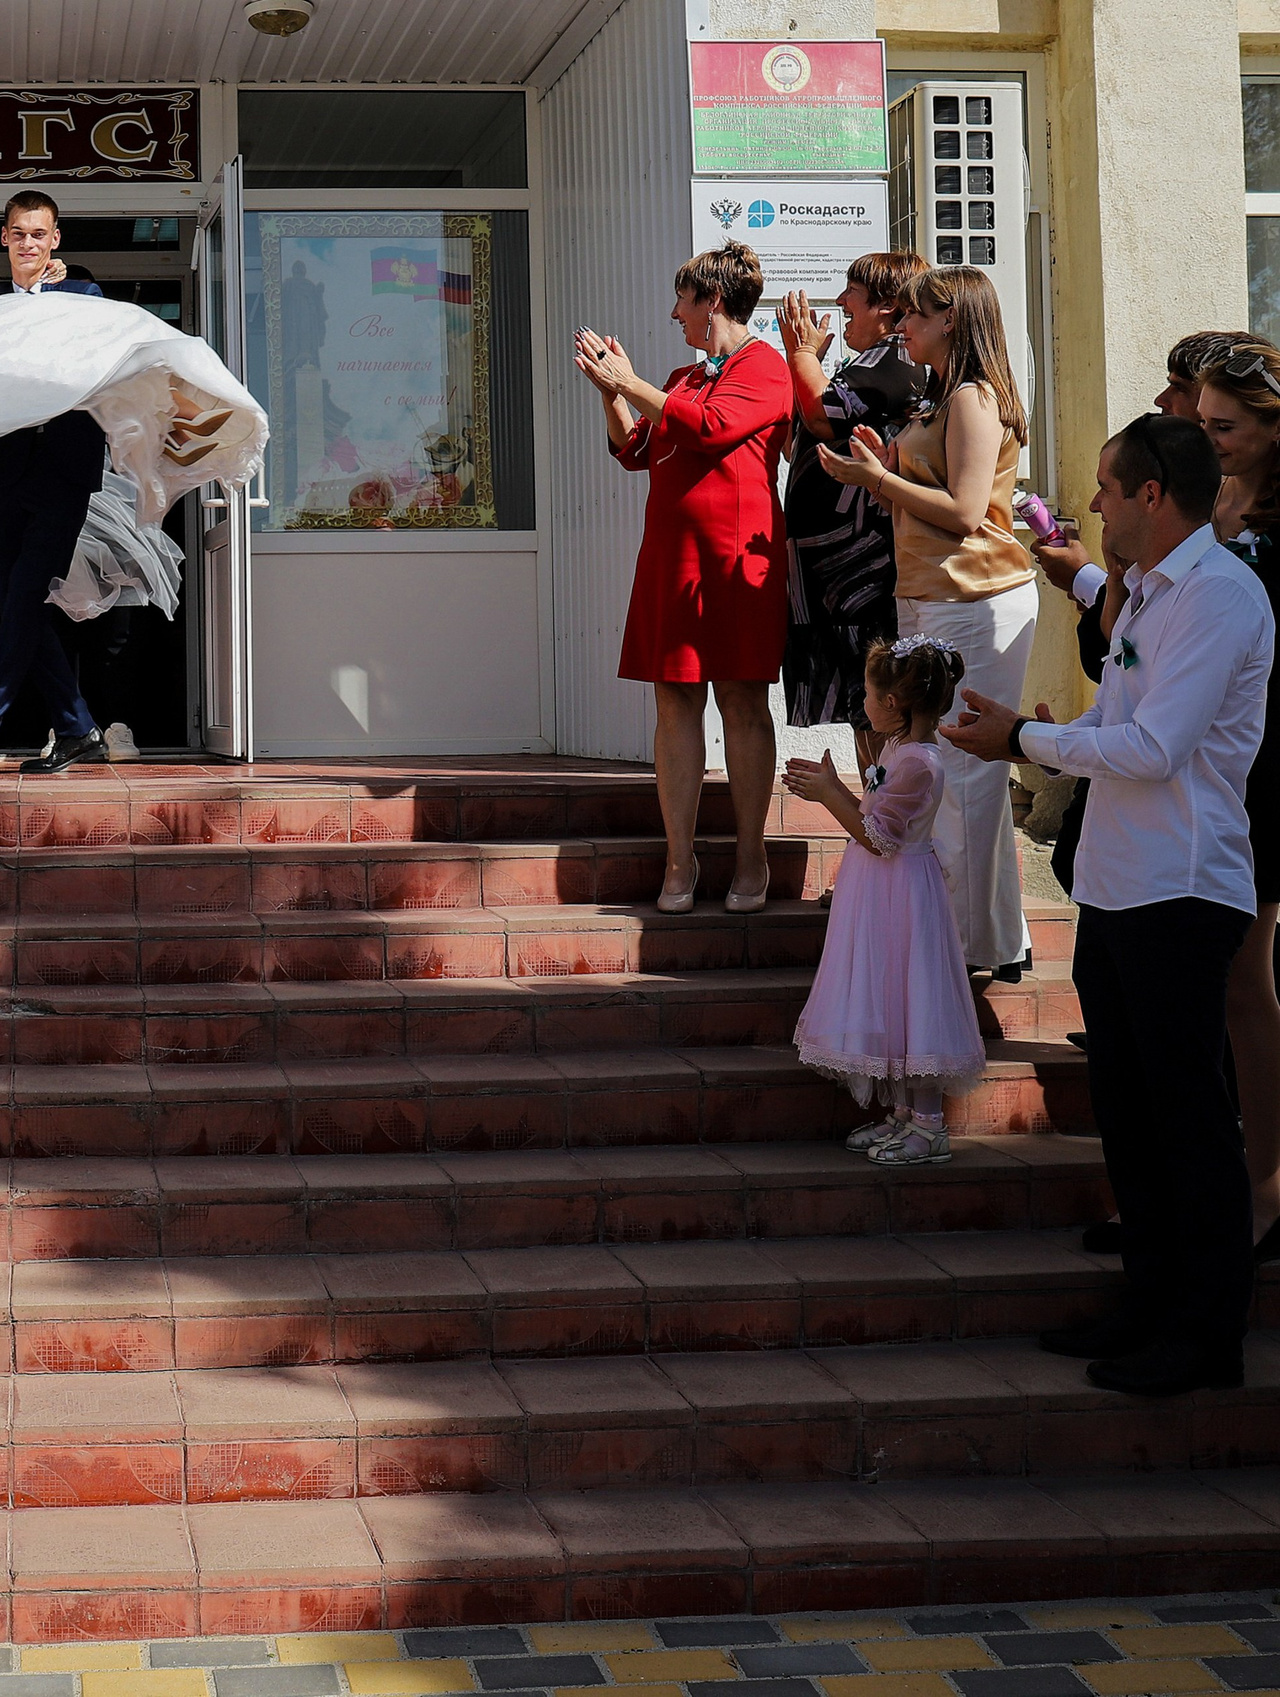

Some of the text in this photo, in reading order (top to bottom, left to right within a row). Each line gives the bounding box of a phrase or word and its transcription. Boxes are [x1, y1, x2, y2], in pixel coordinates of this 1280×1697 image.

[779, 203, 865, 217] Роскадастр
[790, 218, 851, 227] Краснодарскому
[348, 314, 395, 338] Все
[336, 360, 432, 372] начинается
[383, 385, 458, 407] с семьи!
